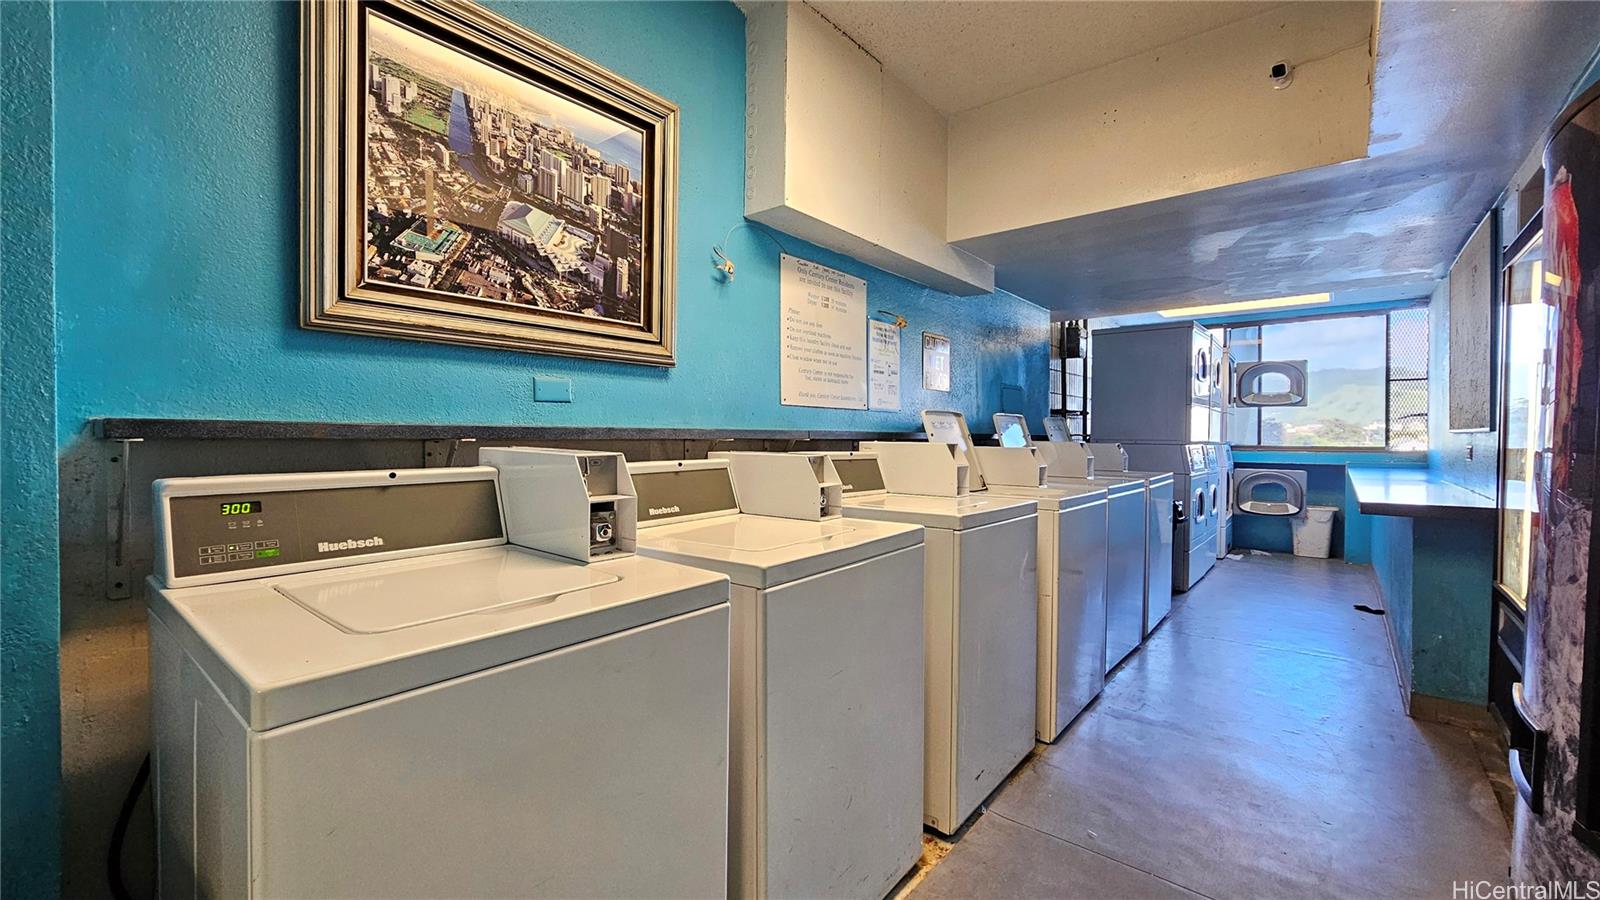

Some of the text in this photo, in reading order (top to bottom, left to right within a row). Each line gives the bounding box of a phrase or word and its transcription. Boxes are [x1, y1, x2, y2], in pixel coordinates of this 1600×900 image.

[797, 267, 807, 276] Only
[809, 270, 824, 281] Century
[825, 276, 838, 285] Center
[222, 503, 251, 515] 300
[649, 505, 680, 516] Huebsch
[318, 536, 384, 553] Huebsch
